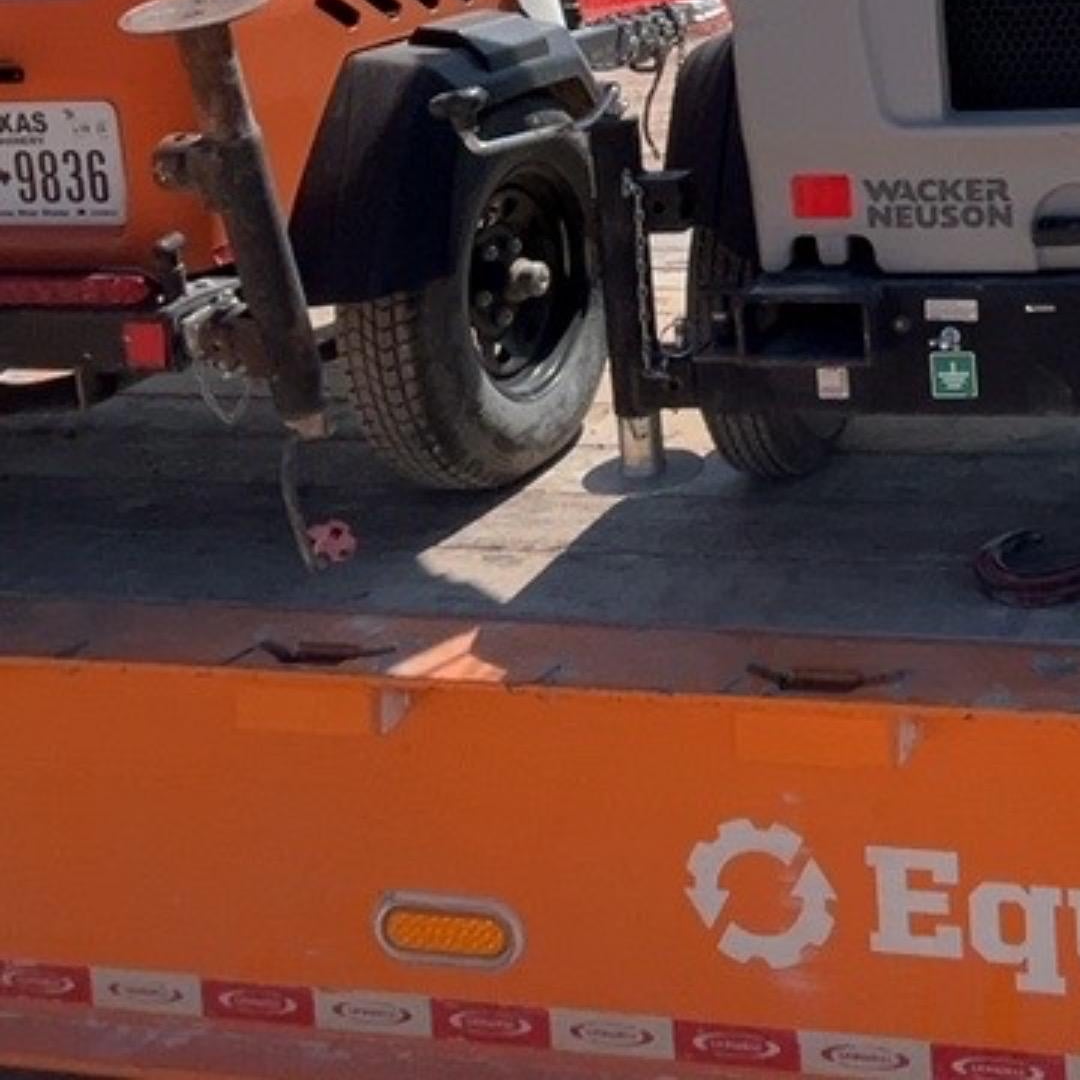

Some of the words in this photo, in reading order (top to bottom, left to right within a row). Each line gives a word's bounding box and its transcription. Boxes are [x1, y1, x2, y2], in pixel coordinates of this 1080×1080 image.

[14, 149, 109, 204] 9836
[861, 178, 1011, 203] WACKER
[866, 204, 1014, 228] NEUSON
